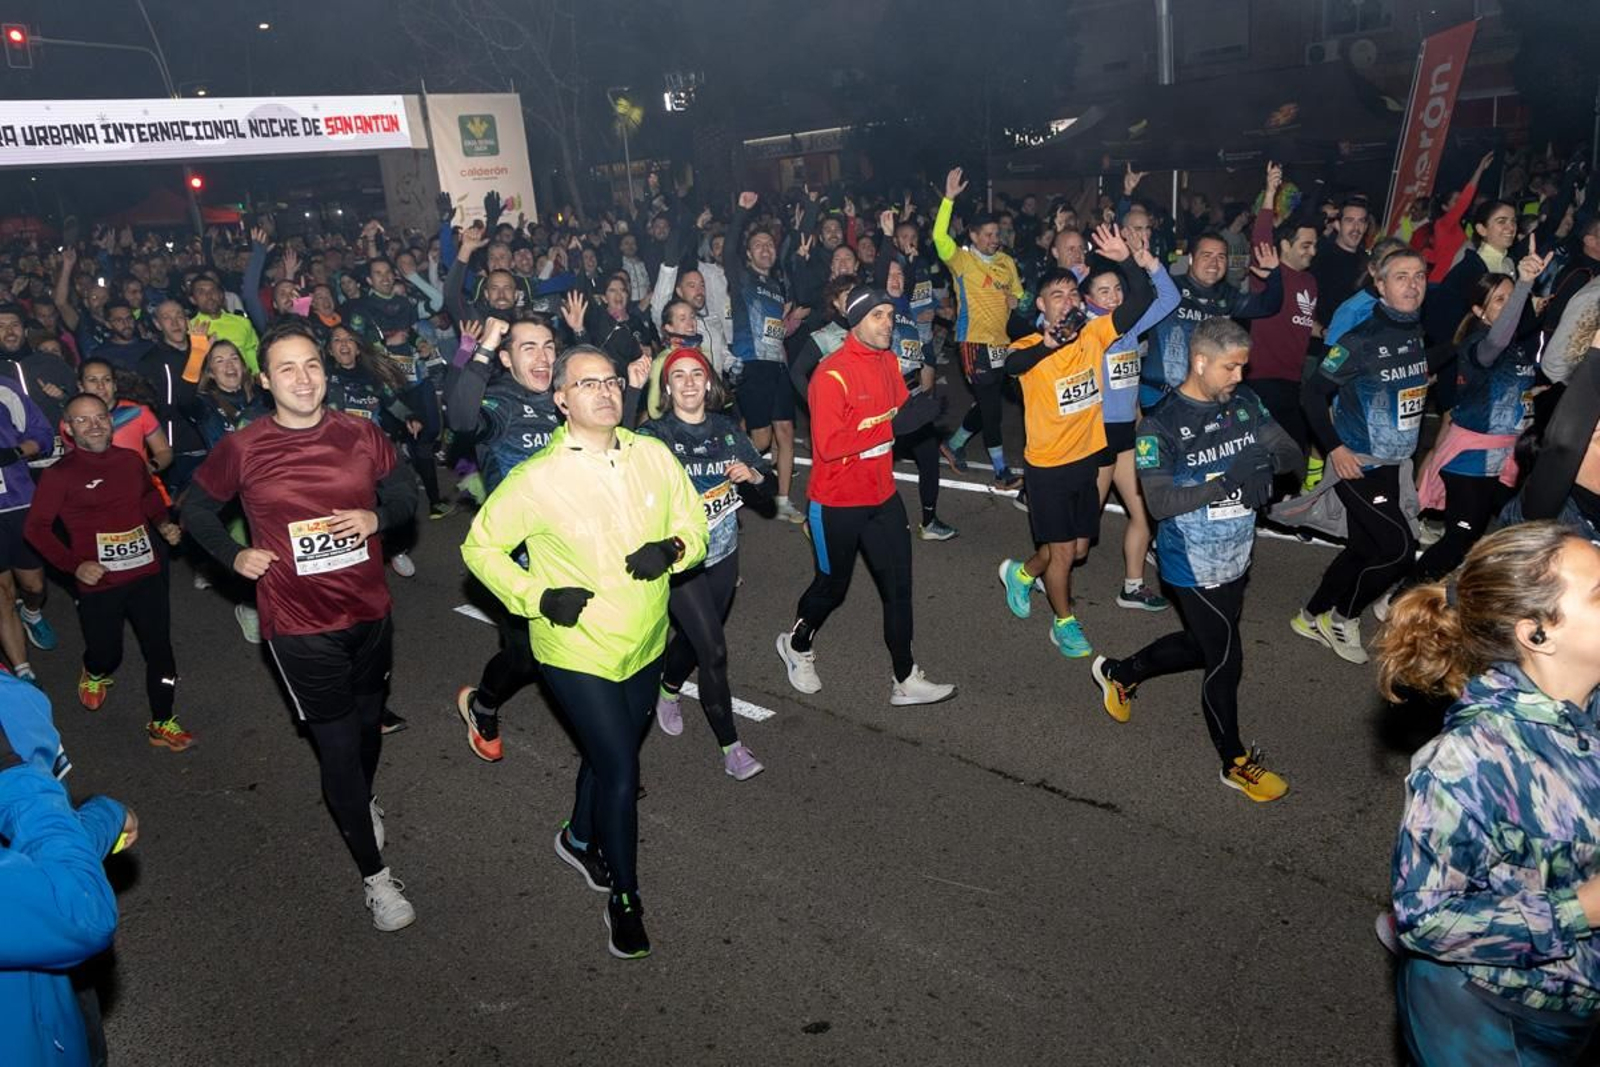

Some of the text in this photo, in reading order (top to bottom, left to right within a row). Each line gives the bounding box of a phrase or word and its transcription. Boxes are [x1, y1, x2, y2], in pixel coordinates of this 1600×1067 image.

[21, 122, 99, 146] URBANA
[100, 119, 247, 144] INTERNACIONAL
[247, 117, 300, 139] NOCHE
[301, 116, 323, 136] DE
[324, 115, 354, 136] SAN
[460, 165, 508, 178] calderón
[1177, 307, 1202, 321] SAN
[1380, 366, 1406, 382] SAN
[1062, 378, 1096, 400] 4571
[522, 432, 553, 448] SAN
[1186, 447, 1217, 467] SAN
[684, 462, 702, 477] AN
[104, 538, 147, 557] 5653
